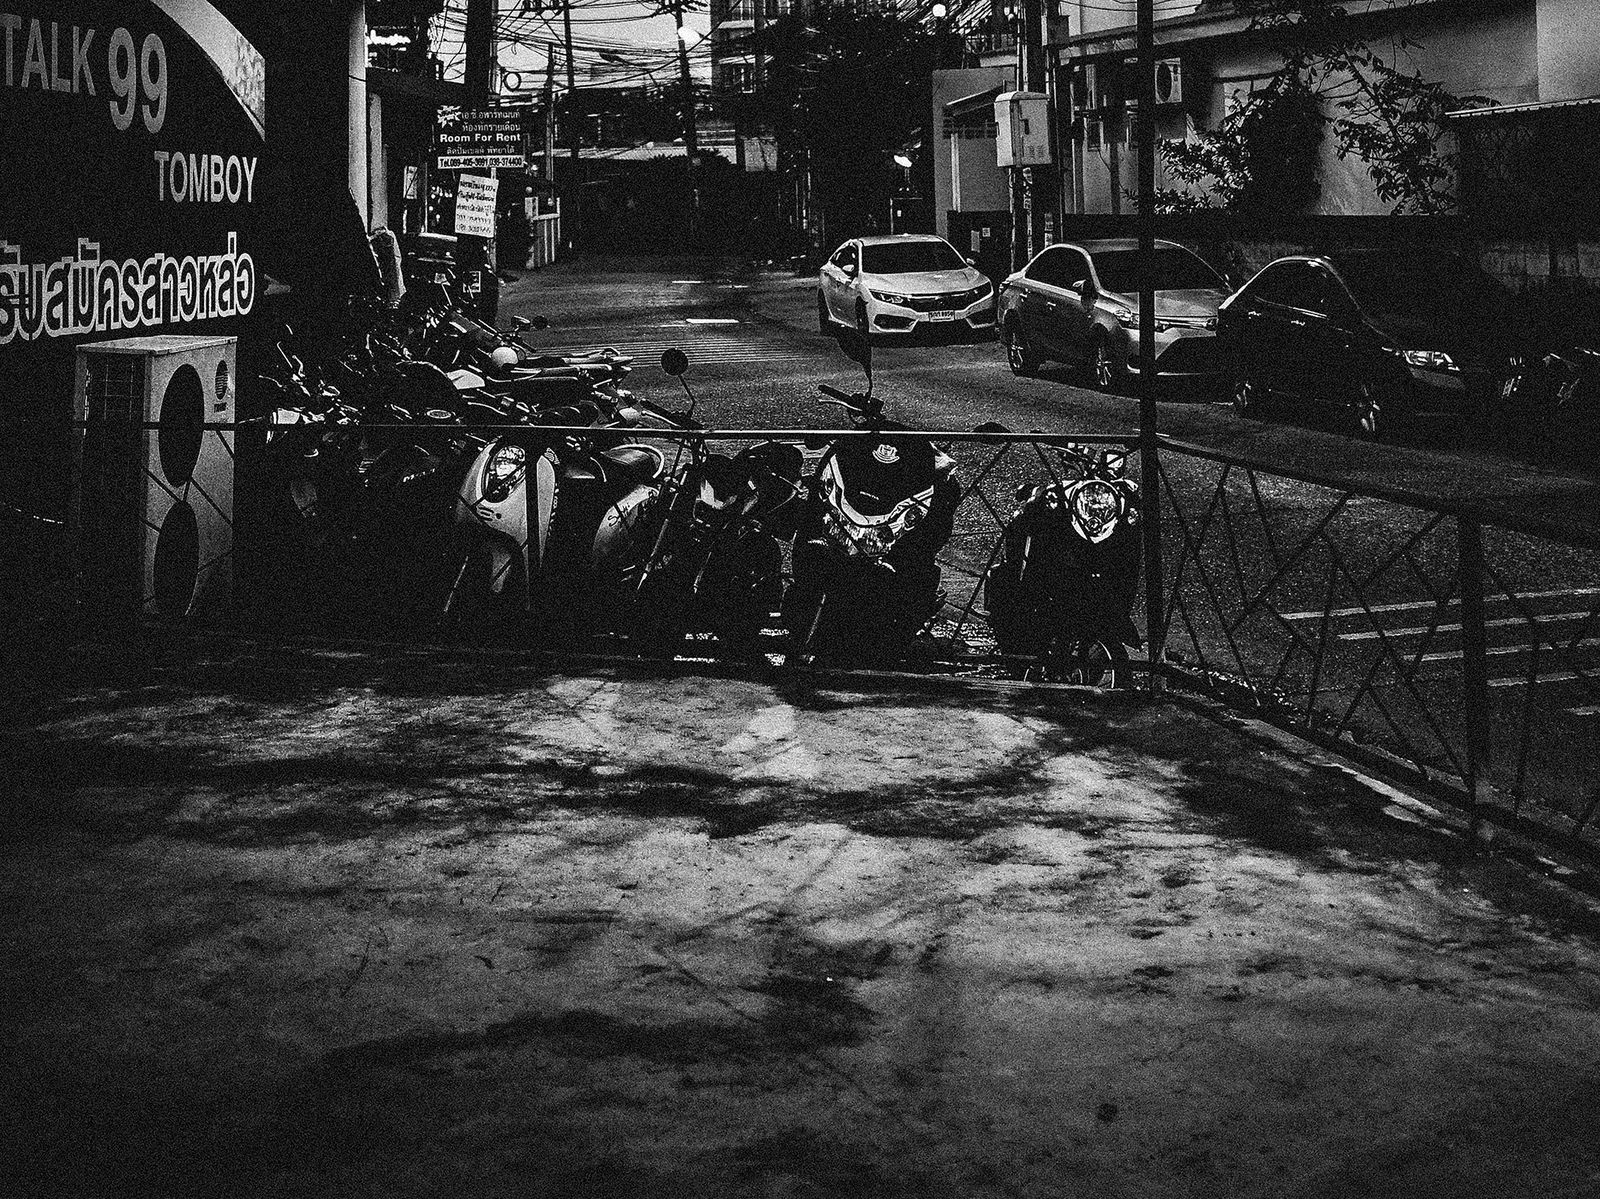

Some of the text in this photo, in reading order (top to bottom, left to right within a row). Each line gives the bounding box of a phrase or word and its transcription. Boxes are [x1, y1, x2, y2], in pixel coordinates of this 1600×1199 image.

[0, 13, 169, 135] TALK 99
[440, 133, 521, 143] Room For Rent
[154, 150, 258, 204] TOMBOY
